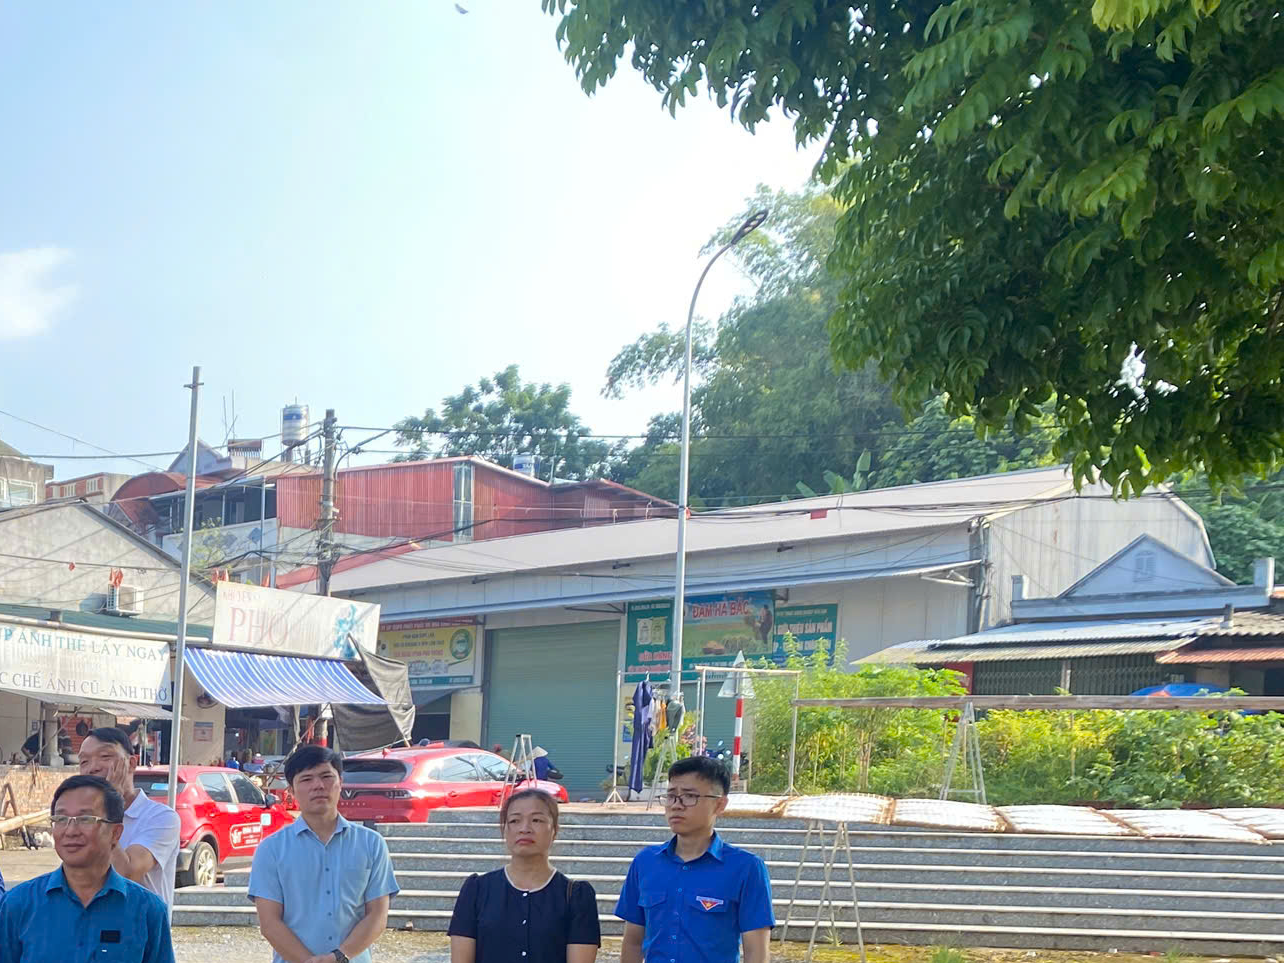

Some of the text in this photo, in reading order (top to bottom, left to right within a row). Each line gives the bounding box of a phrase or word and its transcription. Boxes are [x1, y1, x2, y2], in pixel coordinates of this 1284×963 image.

[126, 644, 168, 662] NGAY
[12, 670, 42, 690] CHẾ
[47, 674, 76, 692] ẢNH
[108, 680, 138, 699] ẢNH
